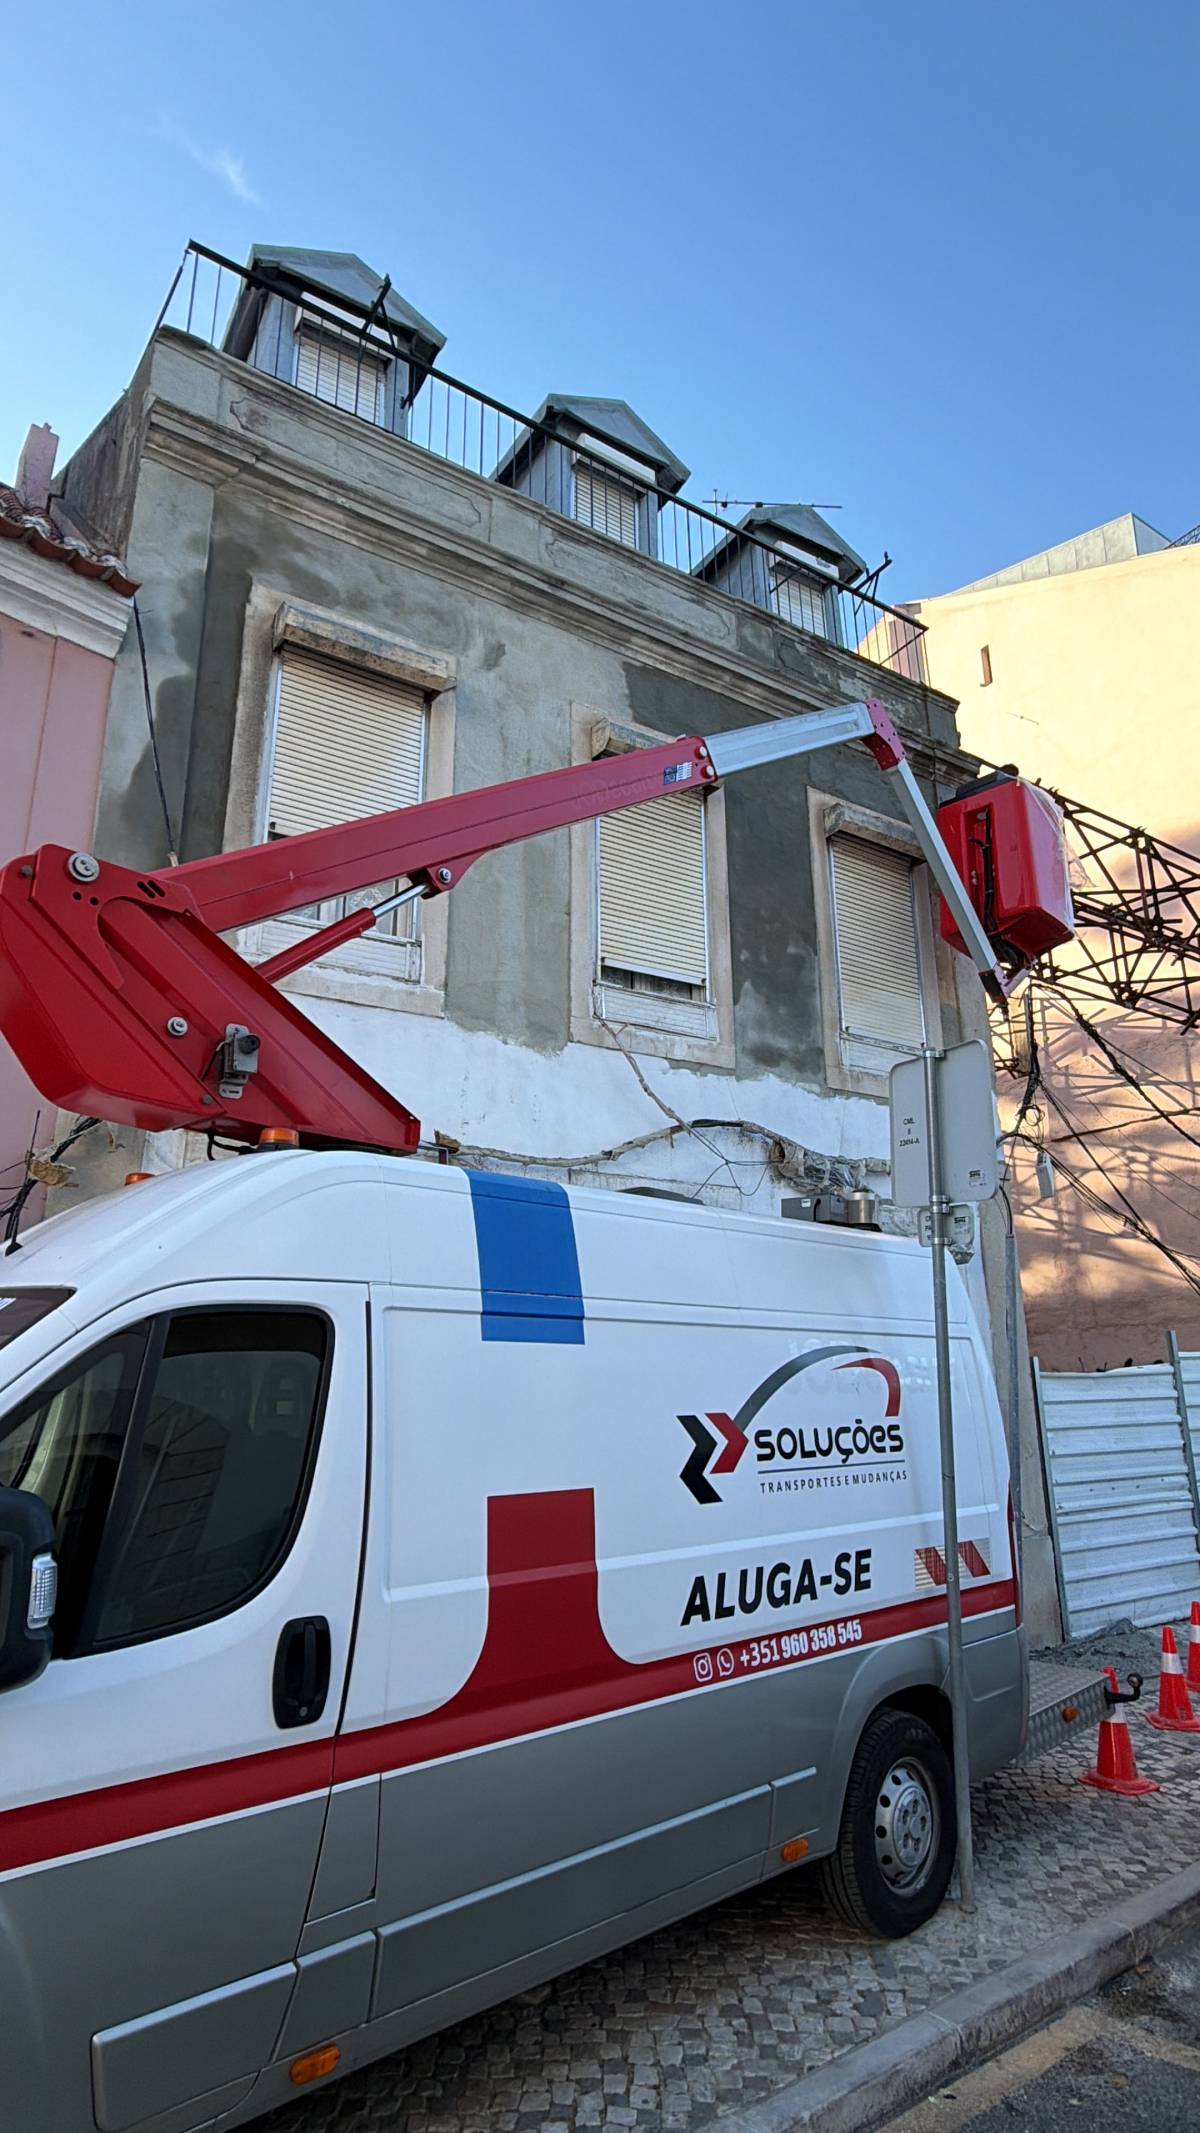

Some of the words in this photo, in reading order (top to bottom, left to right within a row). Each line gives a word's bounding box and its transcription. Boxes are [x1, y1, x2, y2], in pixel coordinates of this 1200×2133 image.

[760, 1475, 842, 1494] TRANSPORTES
[852, 1470, 907, 1485] MUDANÇAS
[680, 1548, 872, 1626] ALUGA-SE
[740, 1639, 780, 1667] +351
[781, 1635, 809, 1659] 960
[810, 1626, 836, 1651] 358
[838, 1619, 862, 1643] 545
